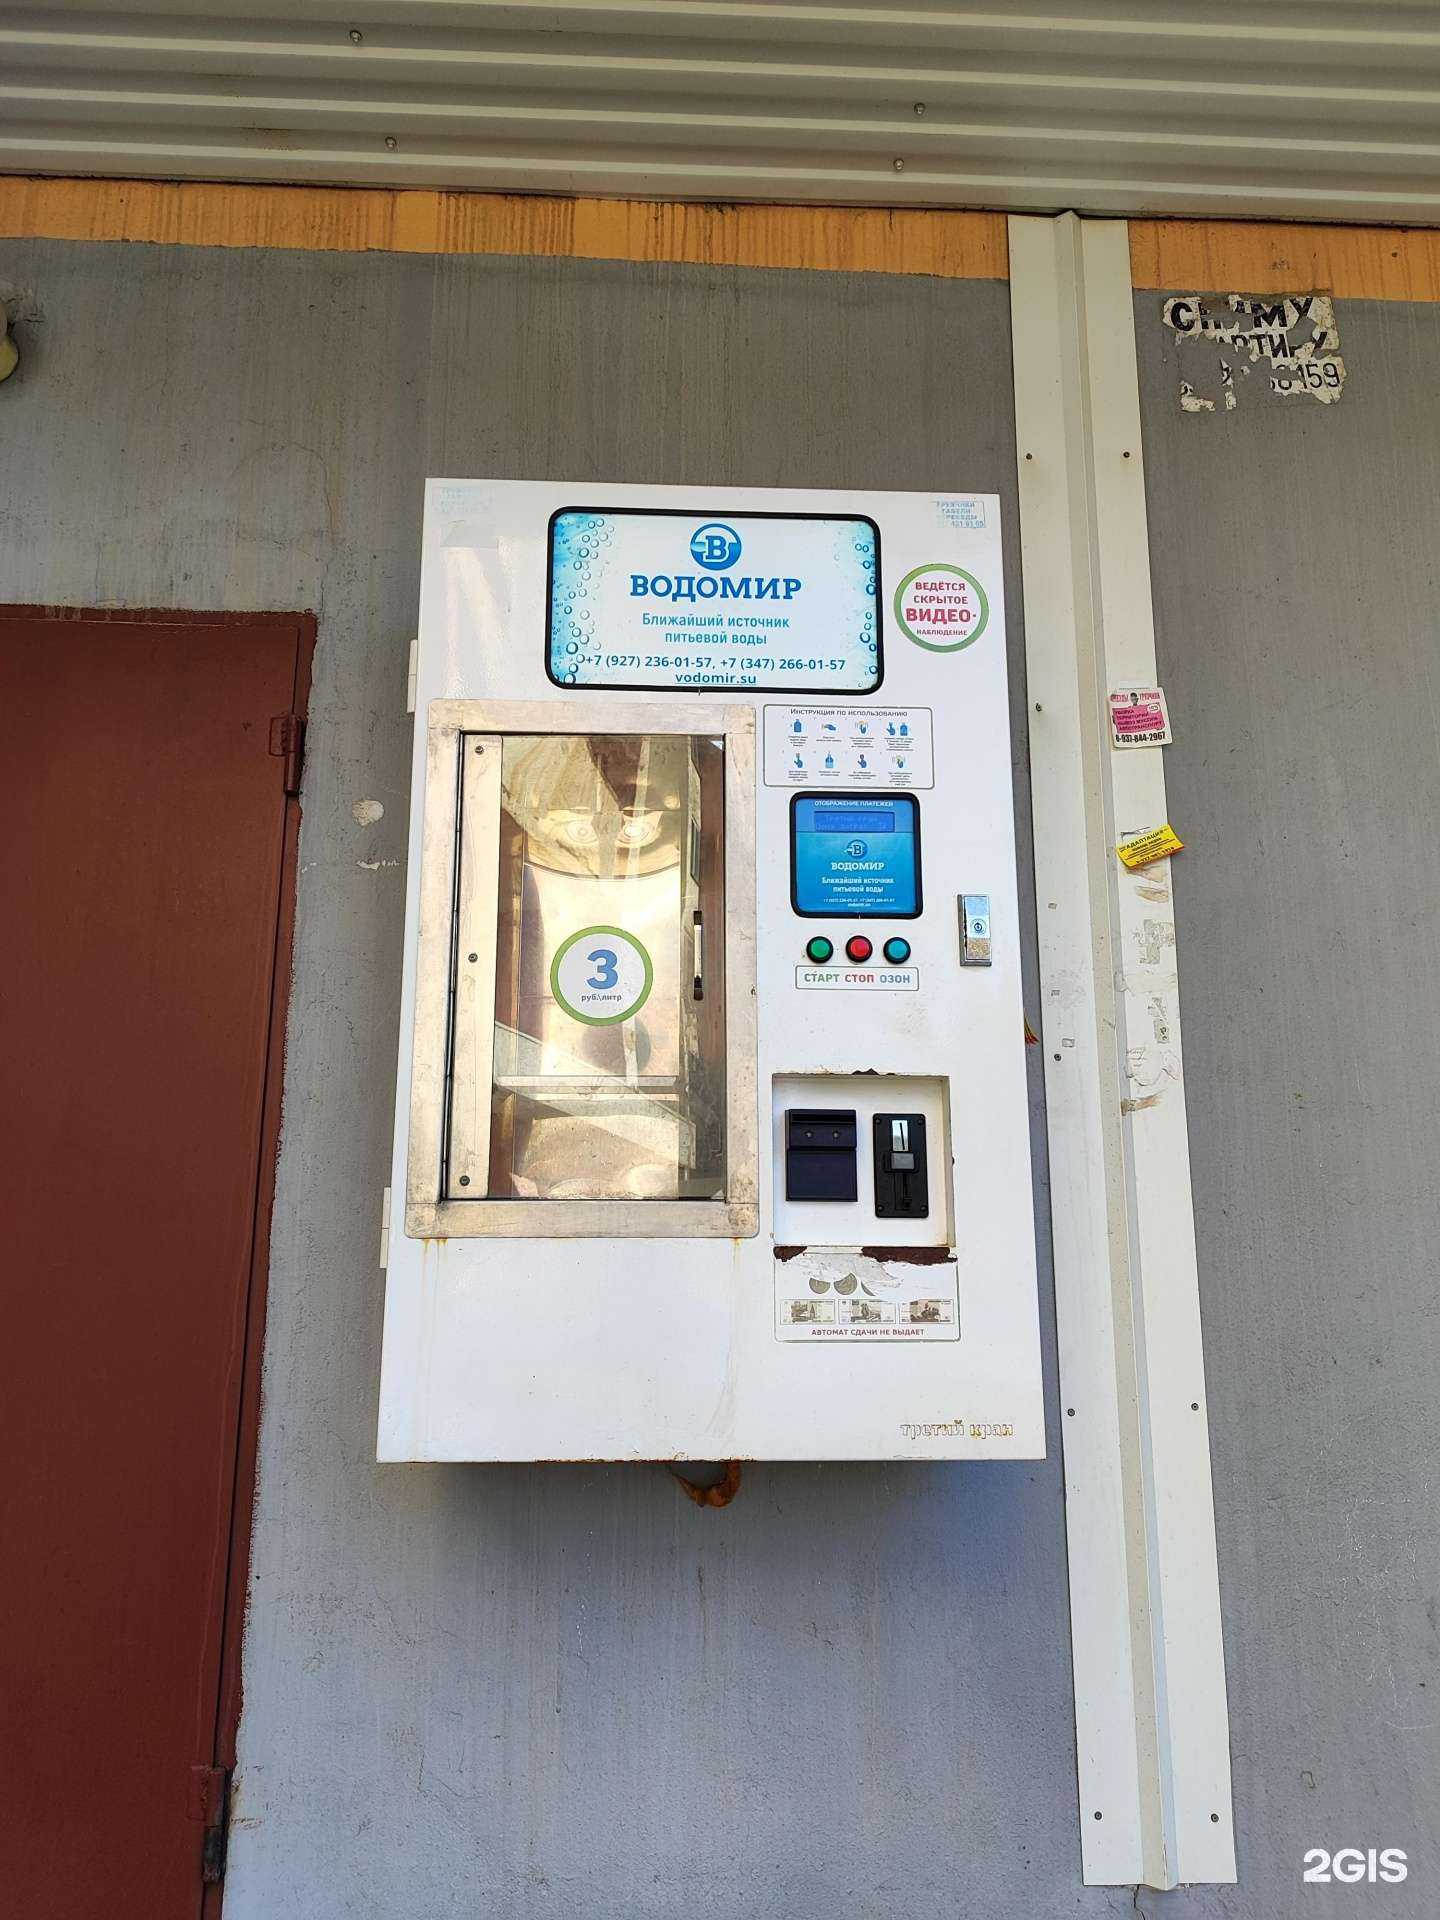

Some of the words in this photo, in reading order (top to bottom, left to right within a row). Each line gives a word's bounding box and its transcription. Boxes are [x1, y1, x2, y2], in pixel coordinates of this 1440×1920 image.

[629, 574, 802, 603] ВОДОМИР
[915, 581, 966, 591] ВЕДЁТСЯ
[914, 595, 968, 605] СКРЫТОЕ
[642, 612, 724, 627] Ближайший
[727, 616, 790, 628] источник
[665, 630, 728, 645] питьевой
[731, 633, 768, 646] воды
[585, 655, 602, 667] +7
[605, 654, 641, 668] (927)
[644, 656, 715, 669] 236-01-57,
[720, 657, 736, 669] +7
[740, 657, 775, 671] (347)
[779, 658, 846, 670] 266-01-57
[675, 672, 757, 684] vodomir.su
[831, 862, 885, 871] ВОДОМИР
[821, 876, 862, 884] Ближайший
[832, 885, 864, 893] питьевой
[586, 949, 619, 990] 3
[804, 973, 840, 983] СТАРТ
[844, 974, 875, 983] СТОП
[879, 974, 911, 983] ОЗОН
[811, 1328, 849, 1336] АВТОМАТ
[850, 1329, 878, 1337] СДАЧИ
[892, 1329, 925, 1337] ВЫДАЕТ
[900, 1418, 965, 1440] третий
[969, 1423, 1014, 1440] кран
